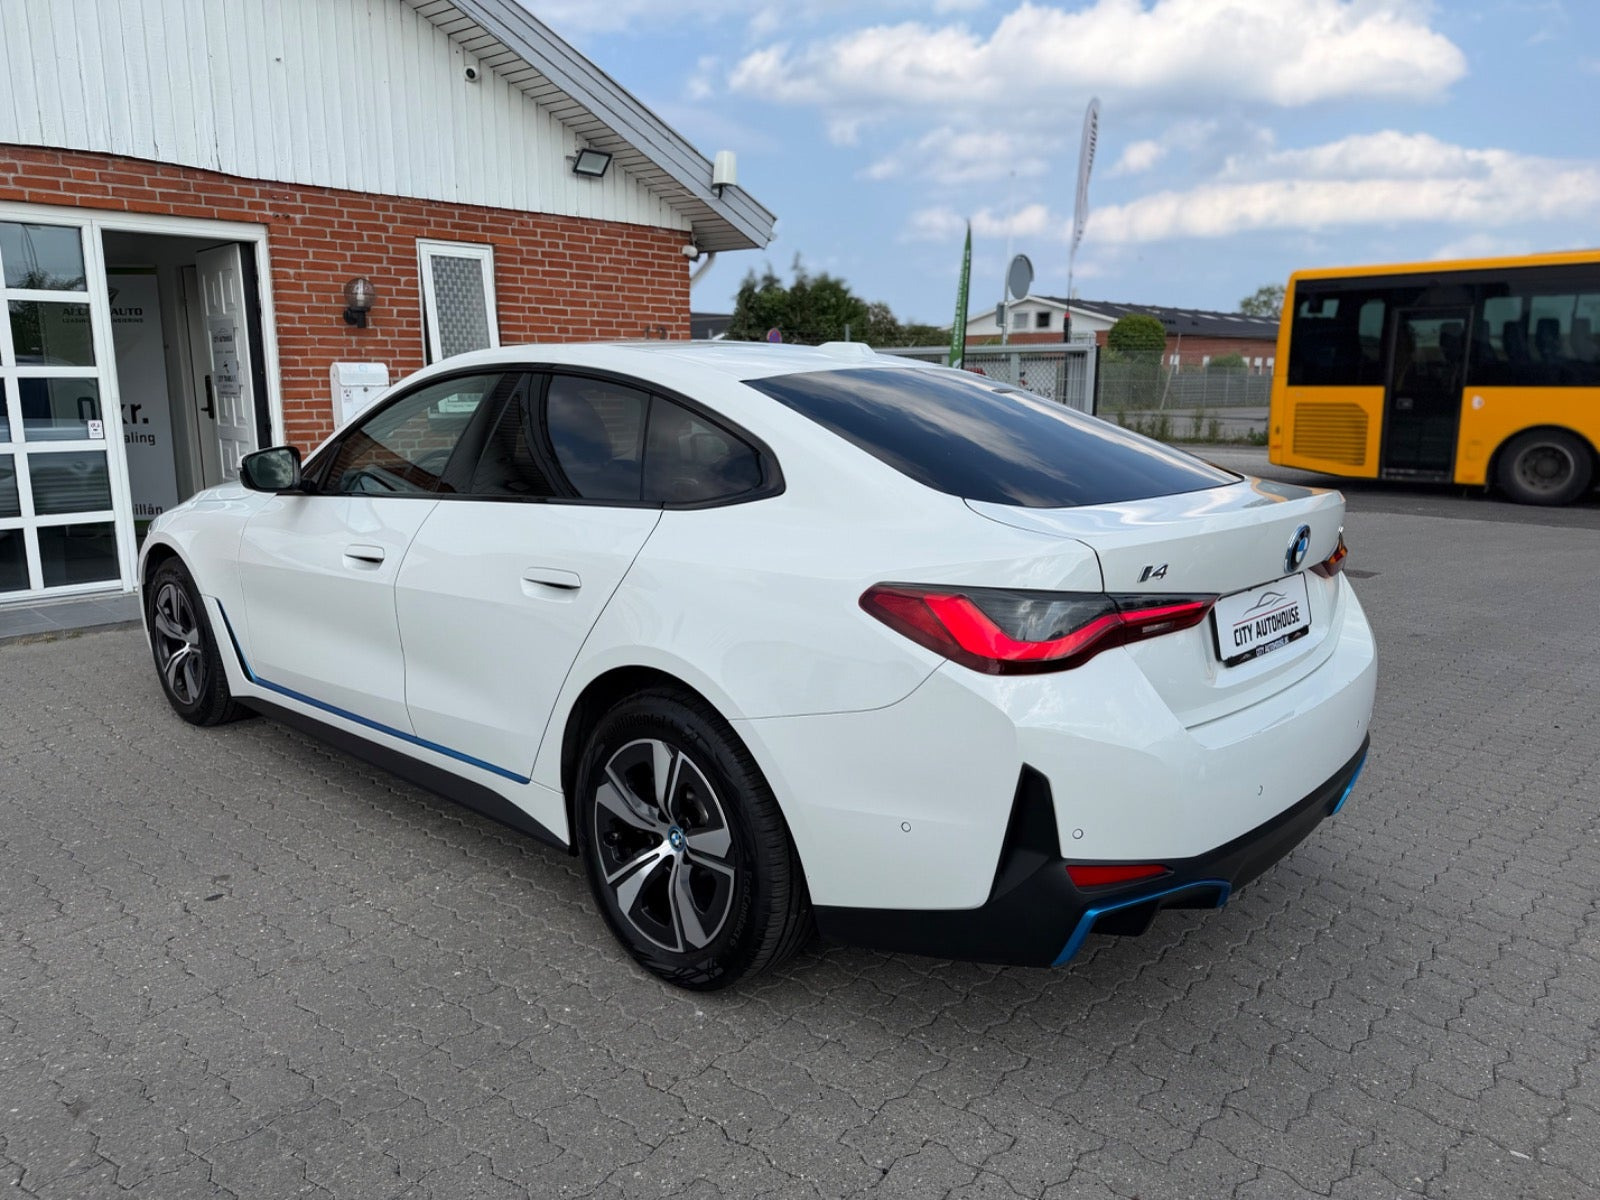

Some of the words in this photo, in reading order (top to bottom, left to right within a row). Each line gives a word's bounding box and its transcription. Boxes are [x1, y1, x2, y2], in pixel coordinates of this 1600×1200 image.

[111, 307, 143, 316] AUTO
[132, 503, 163, 516] illån
[1233, 623, 1253, 647] CITY
[1256, 606, 1300, 639] AUTOHOUSE
[604, 713, 667, 740] ontinental
